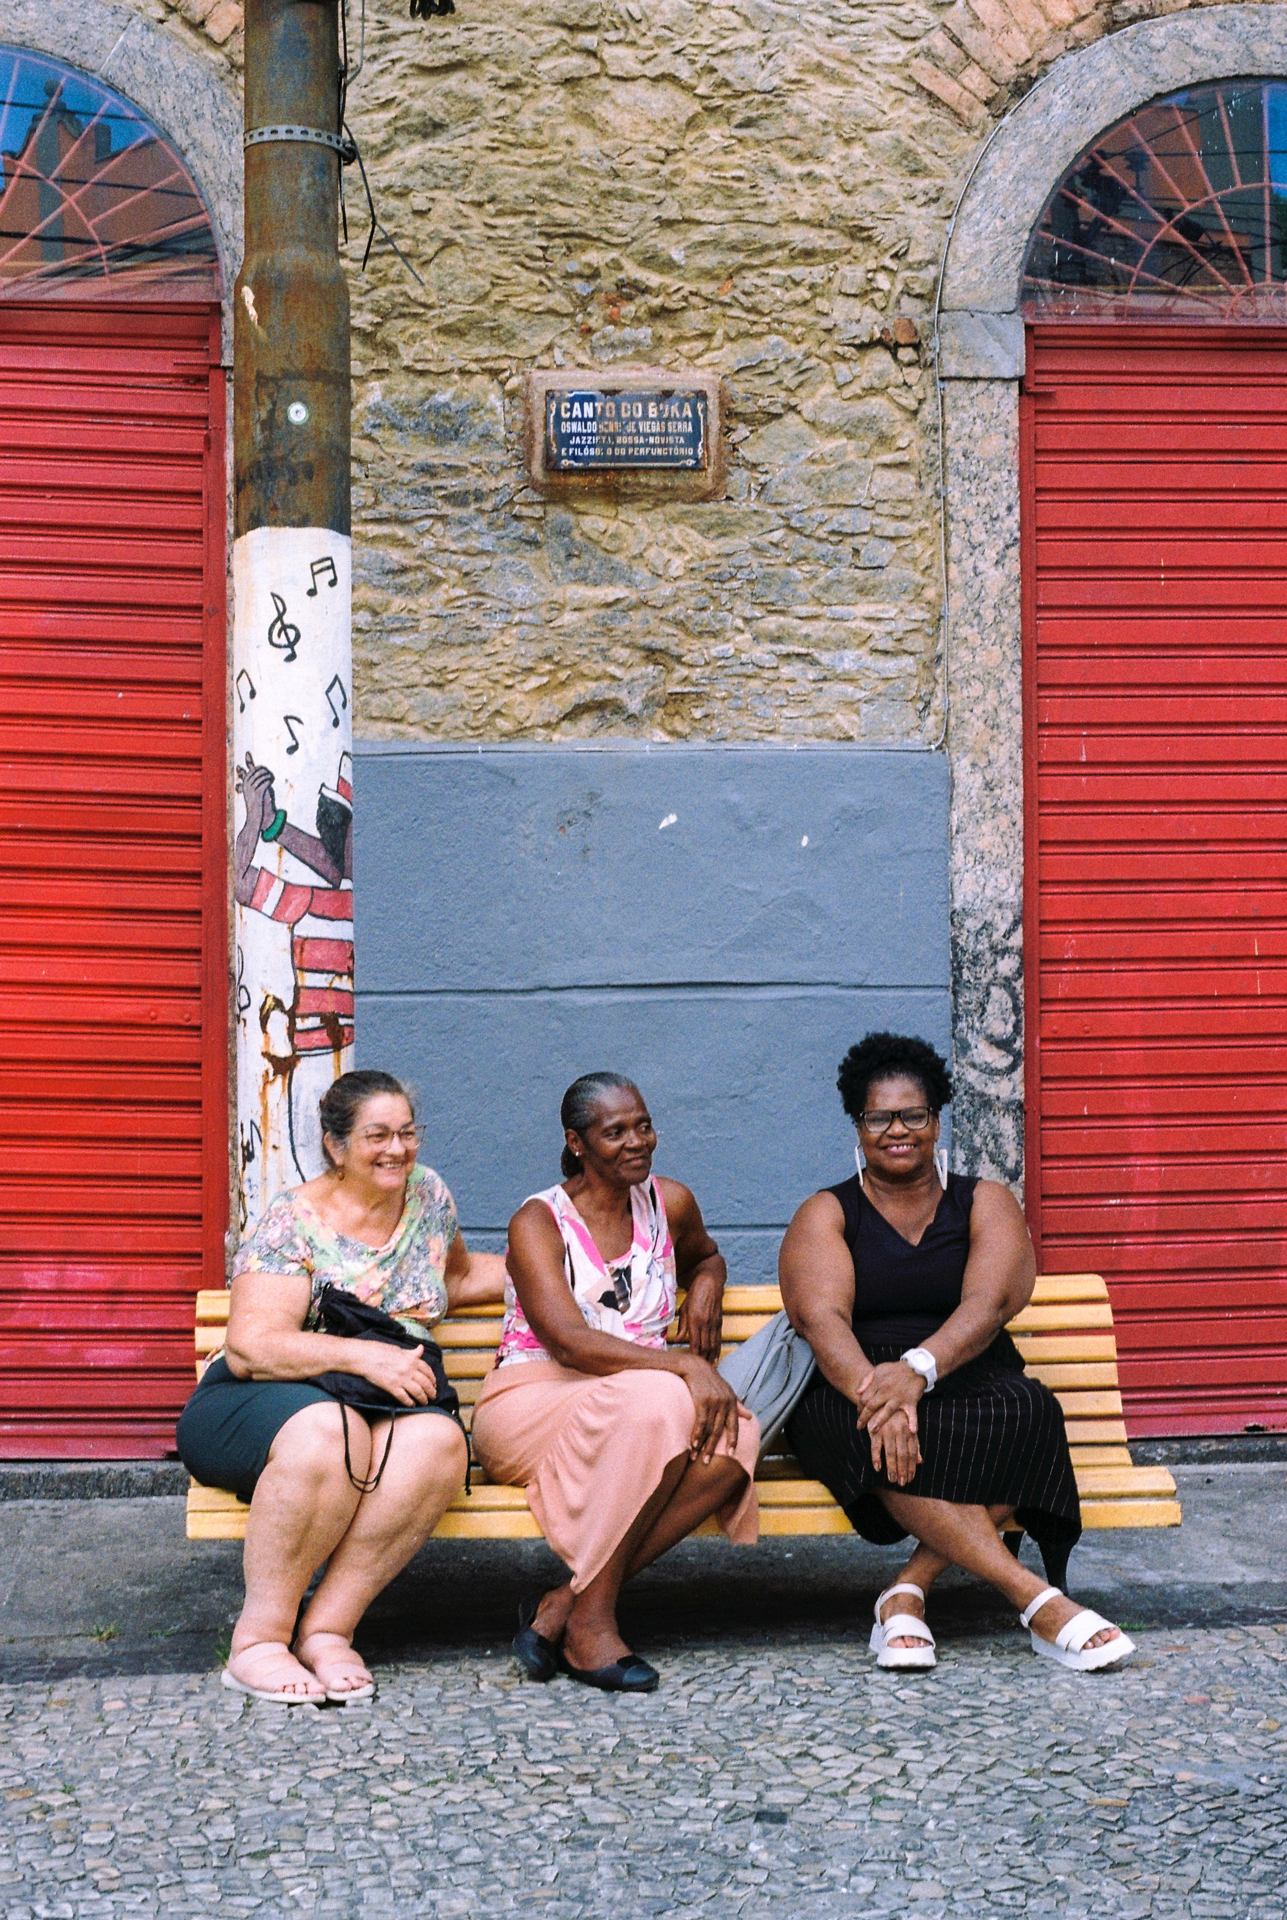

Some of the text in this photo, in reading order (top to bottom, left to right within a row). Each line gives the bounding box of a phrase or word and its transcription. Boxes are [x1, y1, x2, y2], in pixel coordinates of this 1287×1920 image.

[561, 401, 616, 419] CANTO
[621, 401, 642, 419] DO
[561, 421, 597, 433] OSWALDO
[638, 421, 666, 433] VIEGAS
[668, 421, 693, 433] SERRA
[561, 447, 568, 457] E
[614, 447, 626, 457] DO
